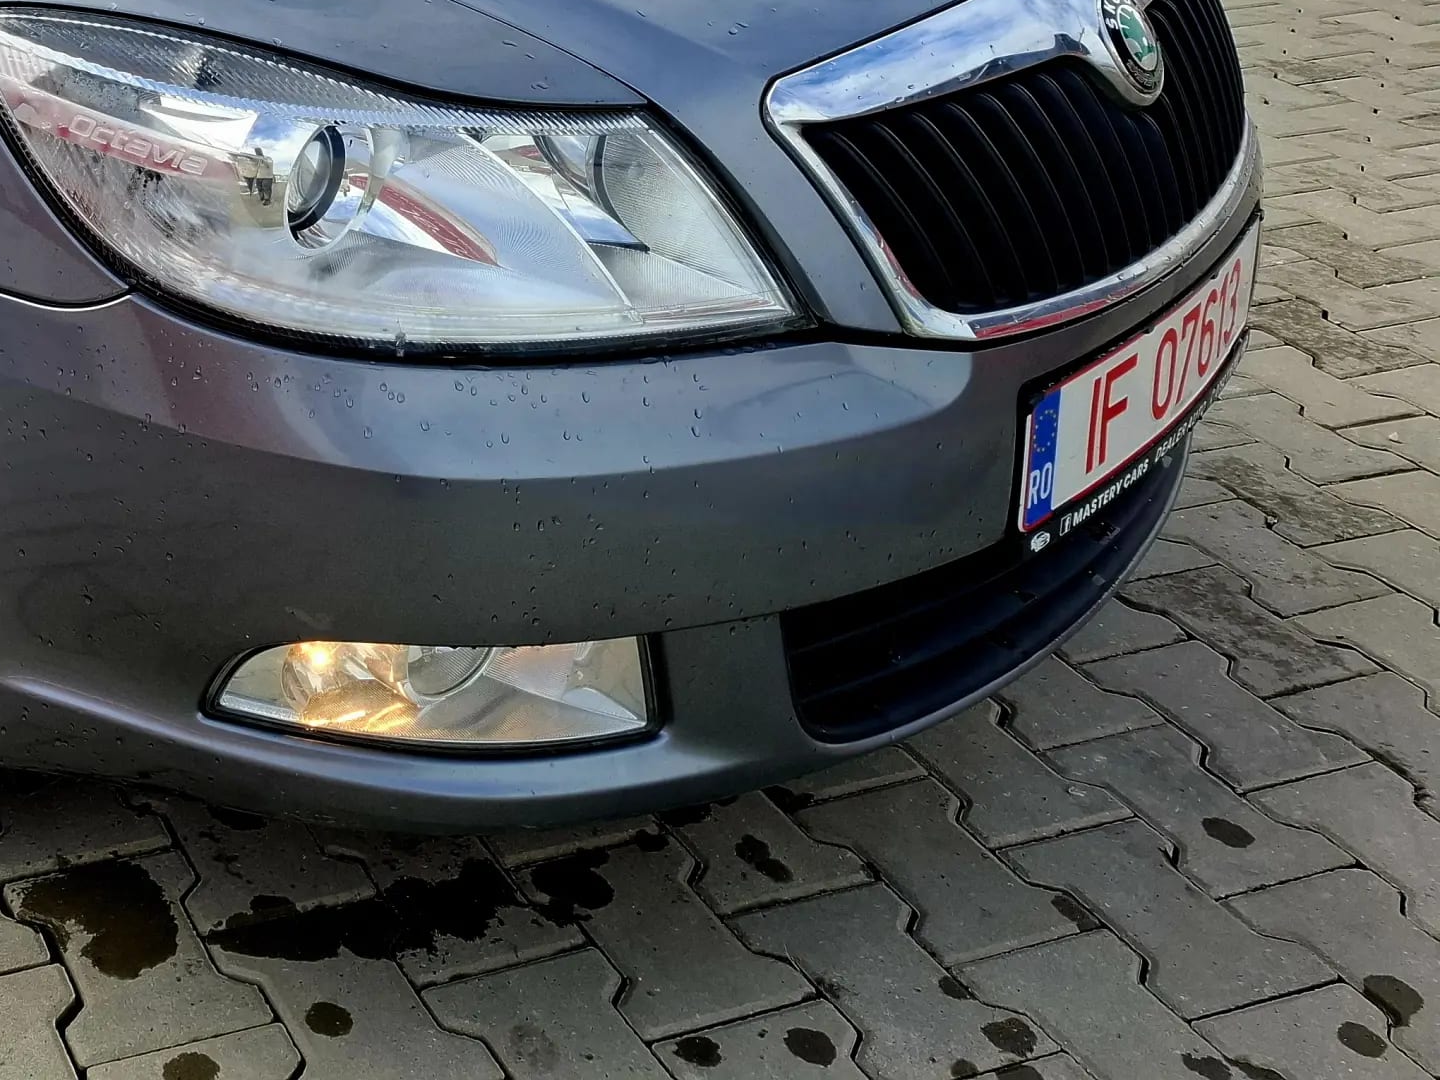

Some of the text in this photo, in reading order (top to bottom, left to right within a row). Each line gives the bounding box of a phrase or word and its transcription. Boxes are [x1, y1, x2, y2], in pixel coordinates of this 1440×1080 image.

[68, 113, 208, 176] Octavia
[1086, 352, 1138, 475] IF
[1151, 258, 1242, 421] 07613
[1027, 461, 1053, 509] RO
[1072, 422, 1187, 527] MASTERY CARS DEALER
